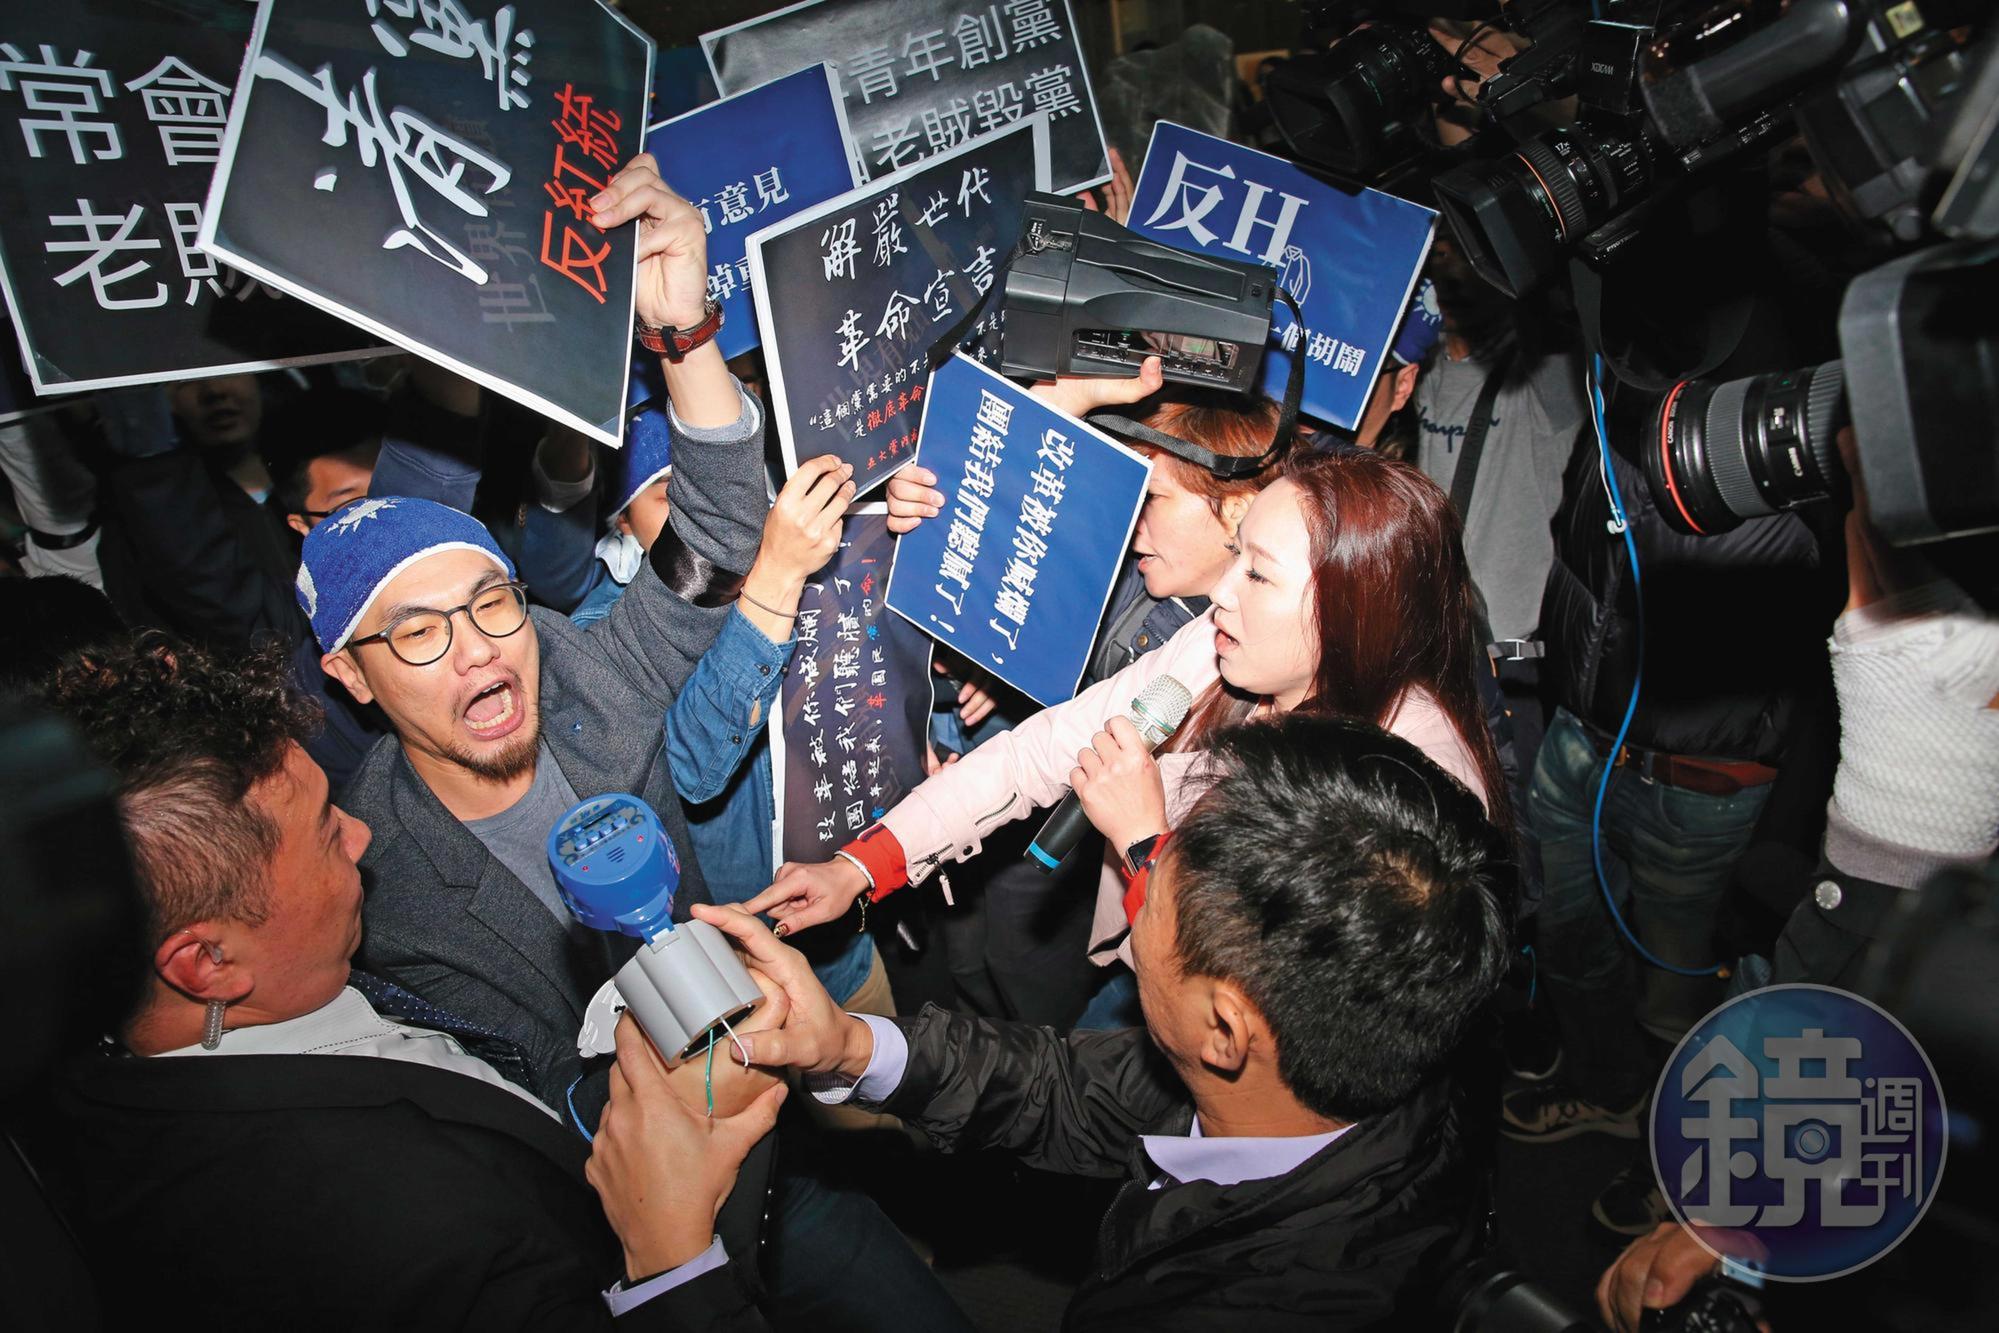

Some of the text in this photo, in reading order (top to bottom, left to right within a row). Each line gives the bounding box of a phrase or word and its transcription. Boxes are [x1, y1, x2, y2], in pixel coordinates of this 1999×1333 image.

[0, 43, 232, 166] 常會
[840, 0, 1063, 105] 青年創黨
[540, 82, 622, 304] 反紅統
